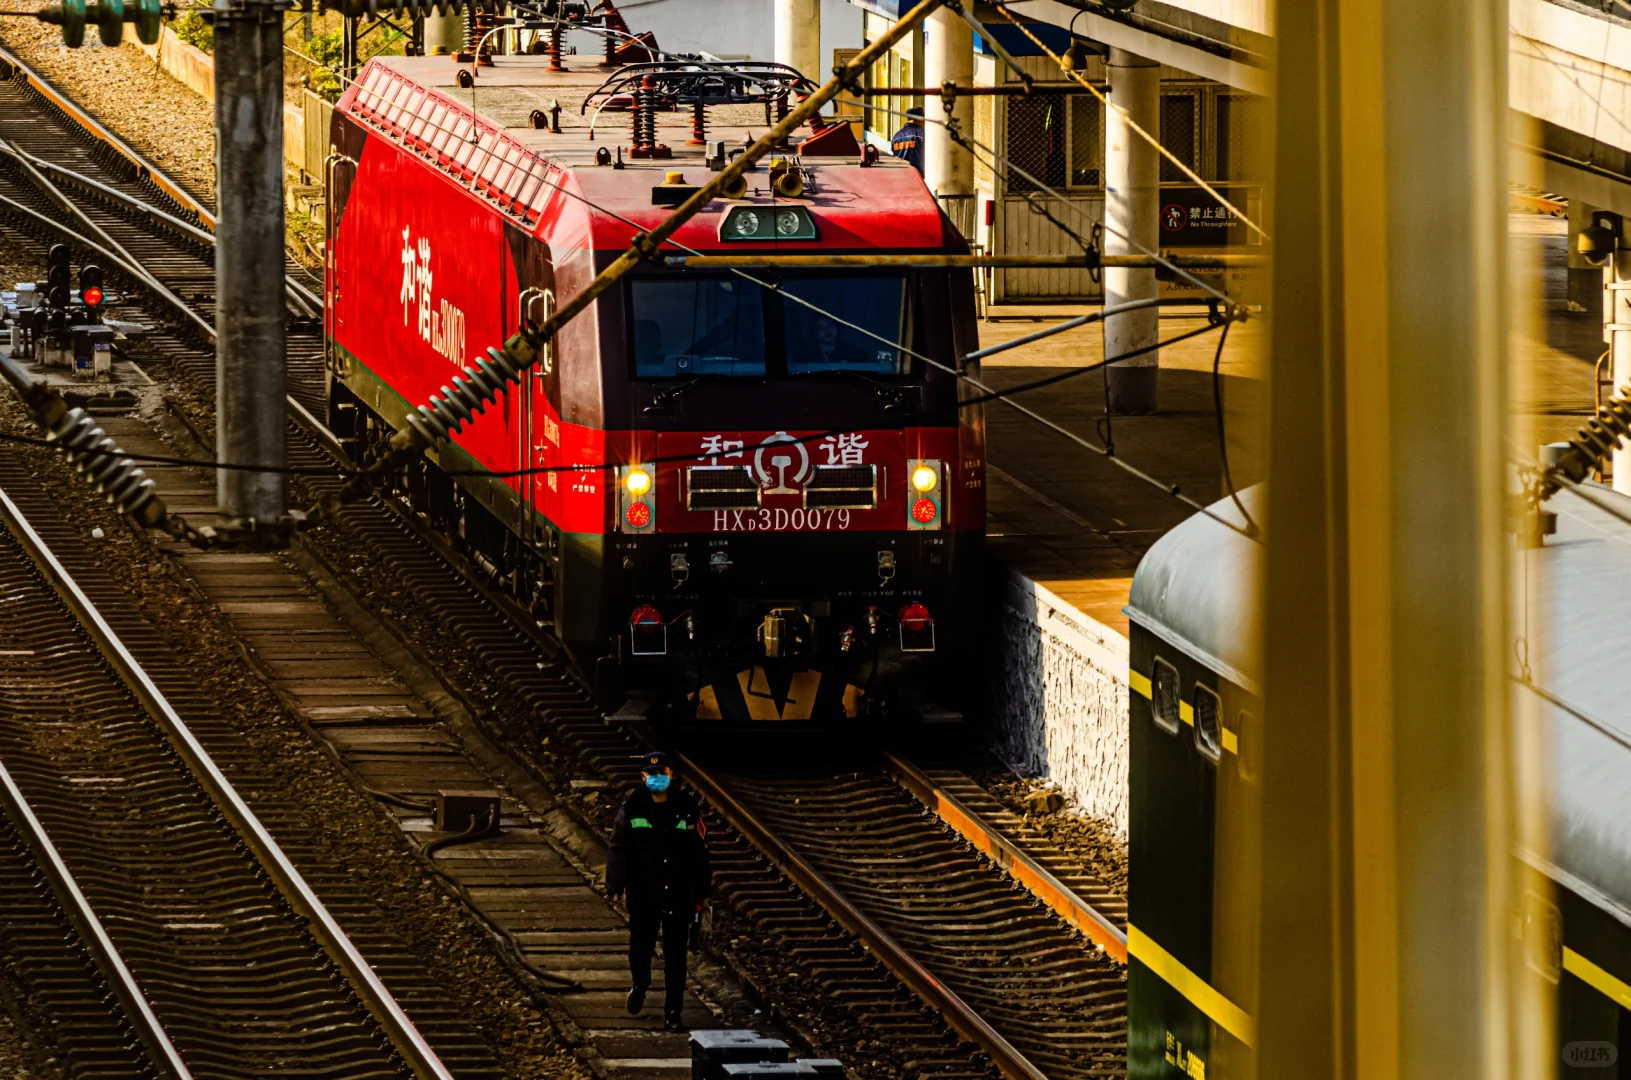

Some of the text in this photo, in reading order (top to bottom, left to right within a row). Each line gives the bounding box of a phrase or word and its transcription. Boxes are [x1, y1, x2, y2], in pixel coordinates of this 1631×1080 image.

[400, 224, 432, 343] 和谐
[697, 432, 869, 466] 和 谐
[713, 508, 851, 531] HXD3D0079
